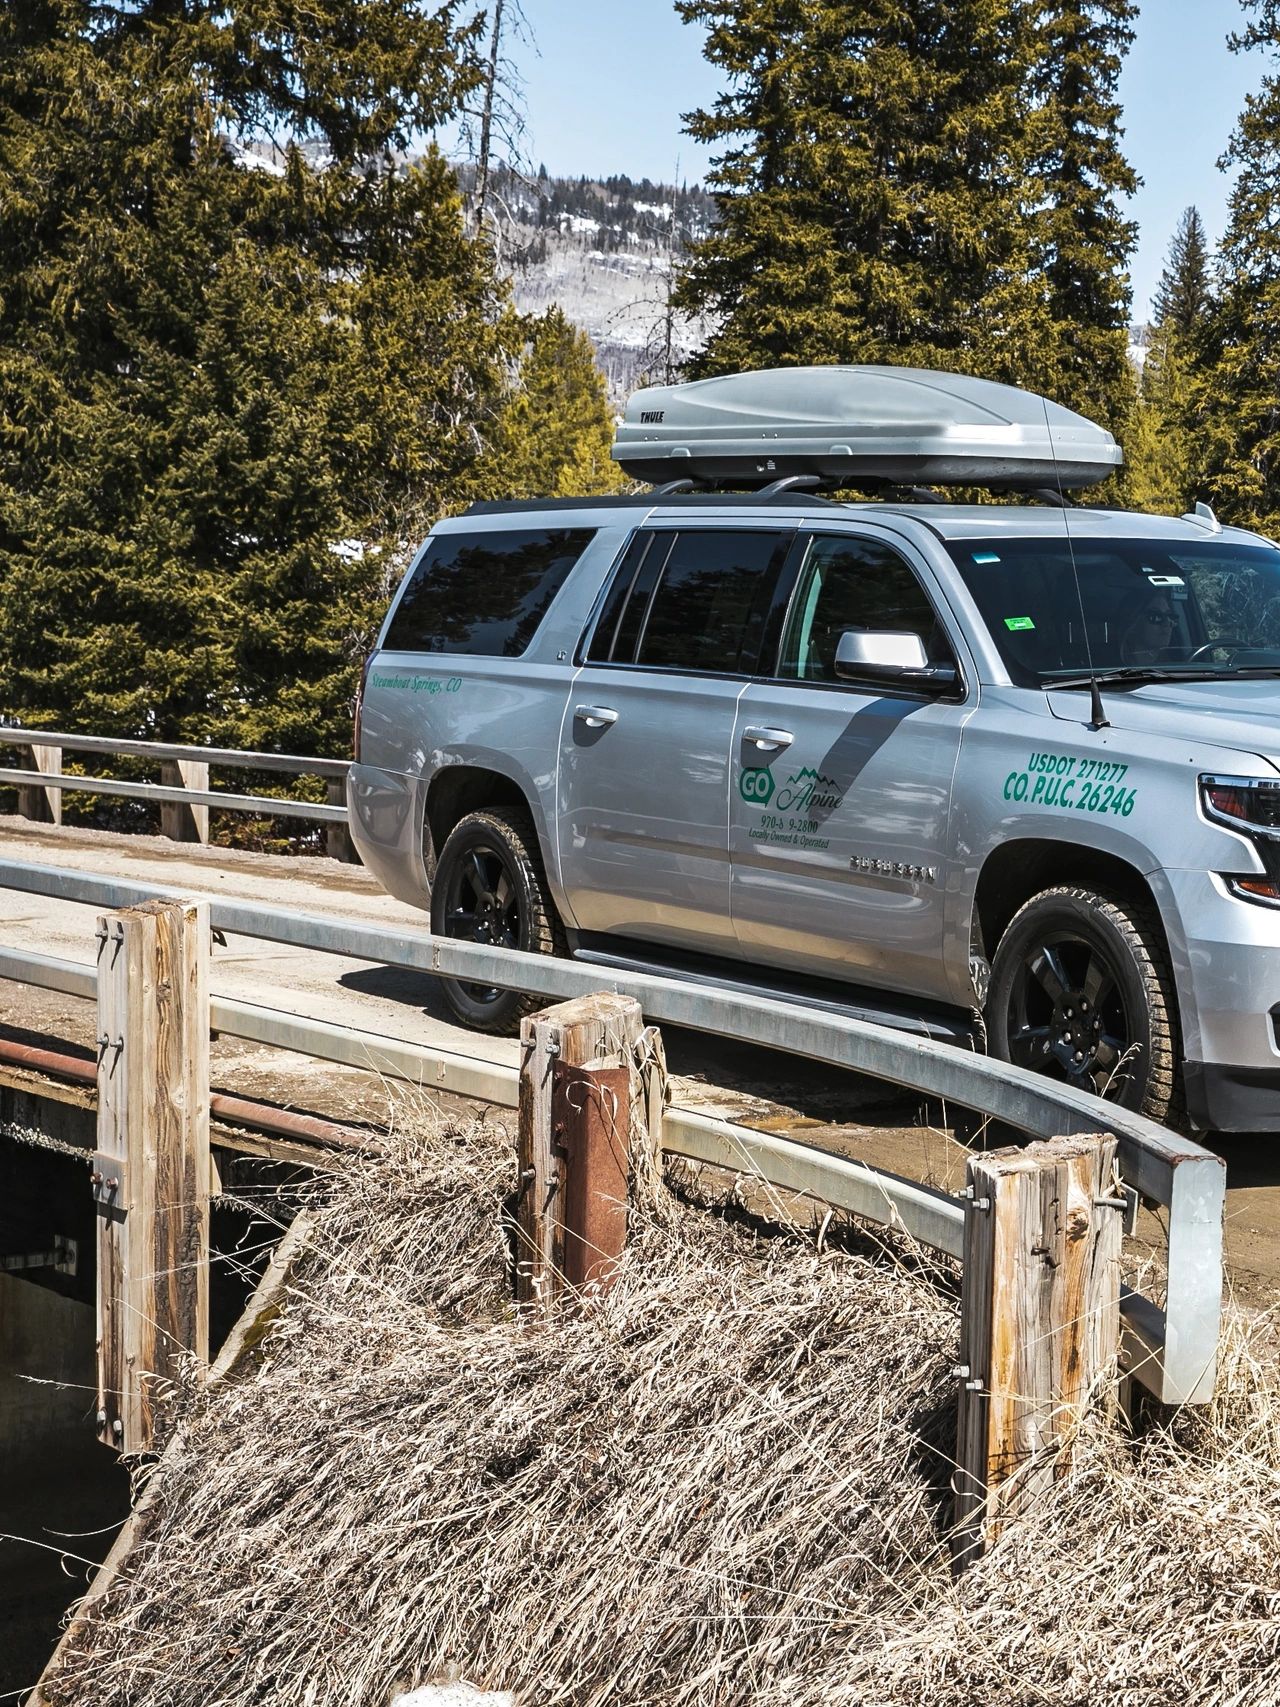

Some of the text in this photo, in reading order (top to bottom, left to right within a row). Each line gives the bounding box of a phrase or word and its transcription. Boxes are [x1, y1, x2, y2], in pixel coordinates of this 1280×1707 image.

[641, 411, 664, 424] THULE
[373, 673, 410, 689] Steamboat
[446, 677, 462, 692] CO
[1028, 753, 1128, 783] USDOT 271277
[742, 771, 843, 812] GO Alpine
[1075, 782, 1138, 816] 26246
[749, 827, 830, 849] Locally Owned & Operated
[850, 855, 936, 881] SUBURBAN
